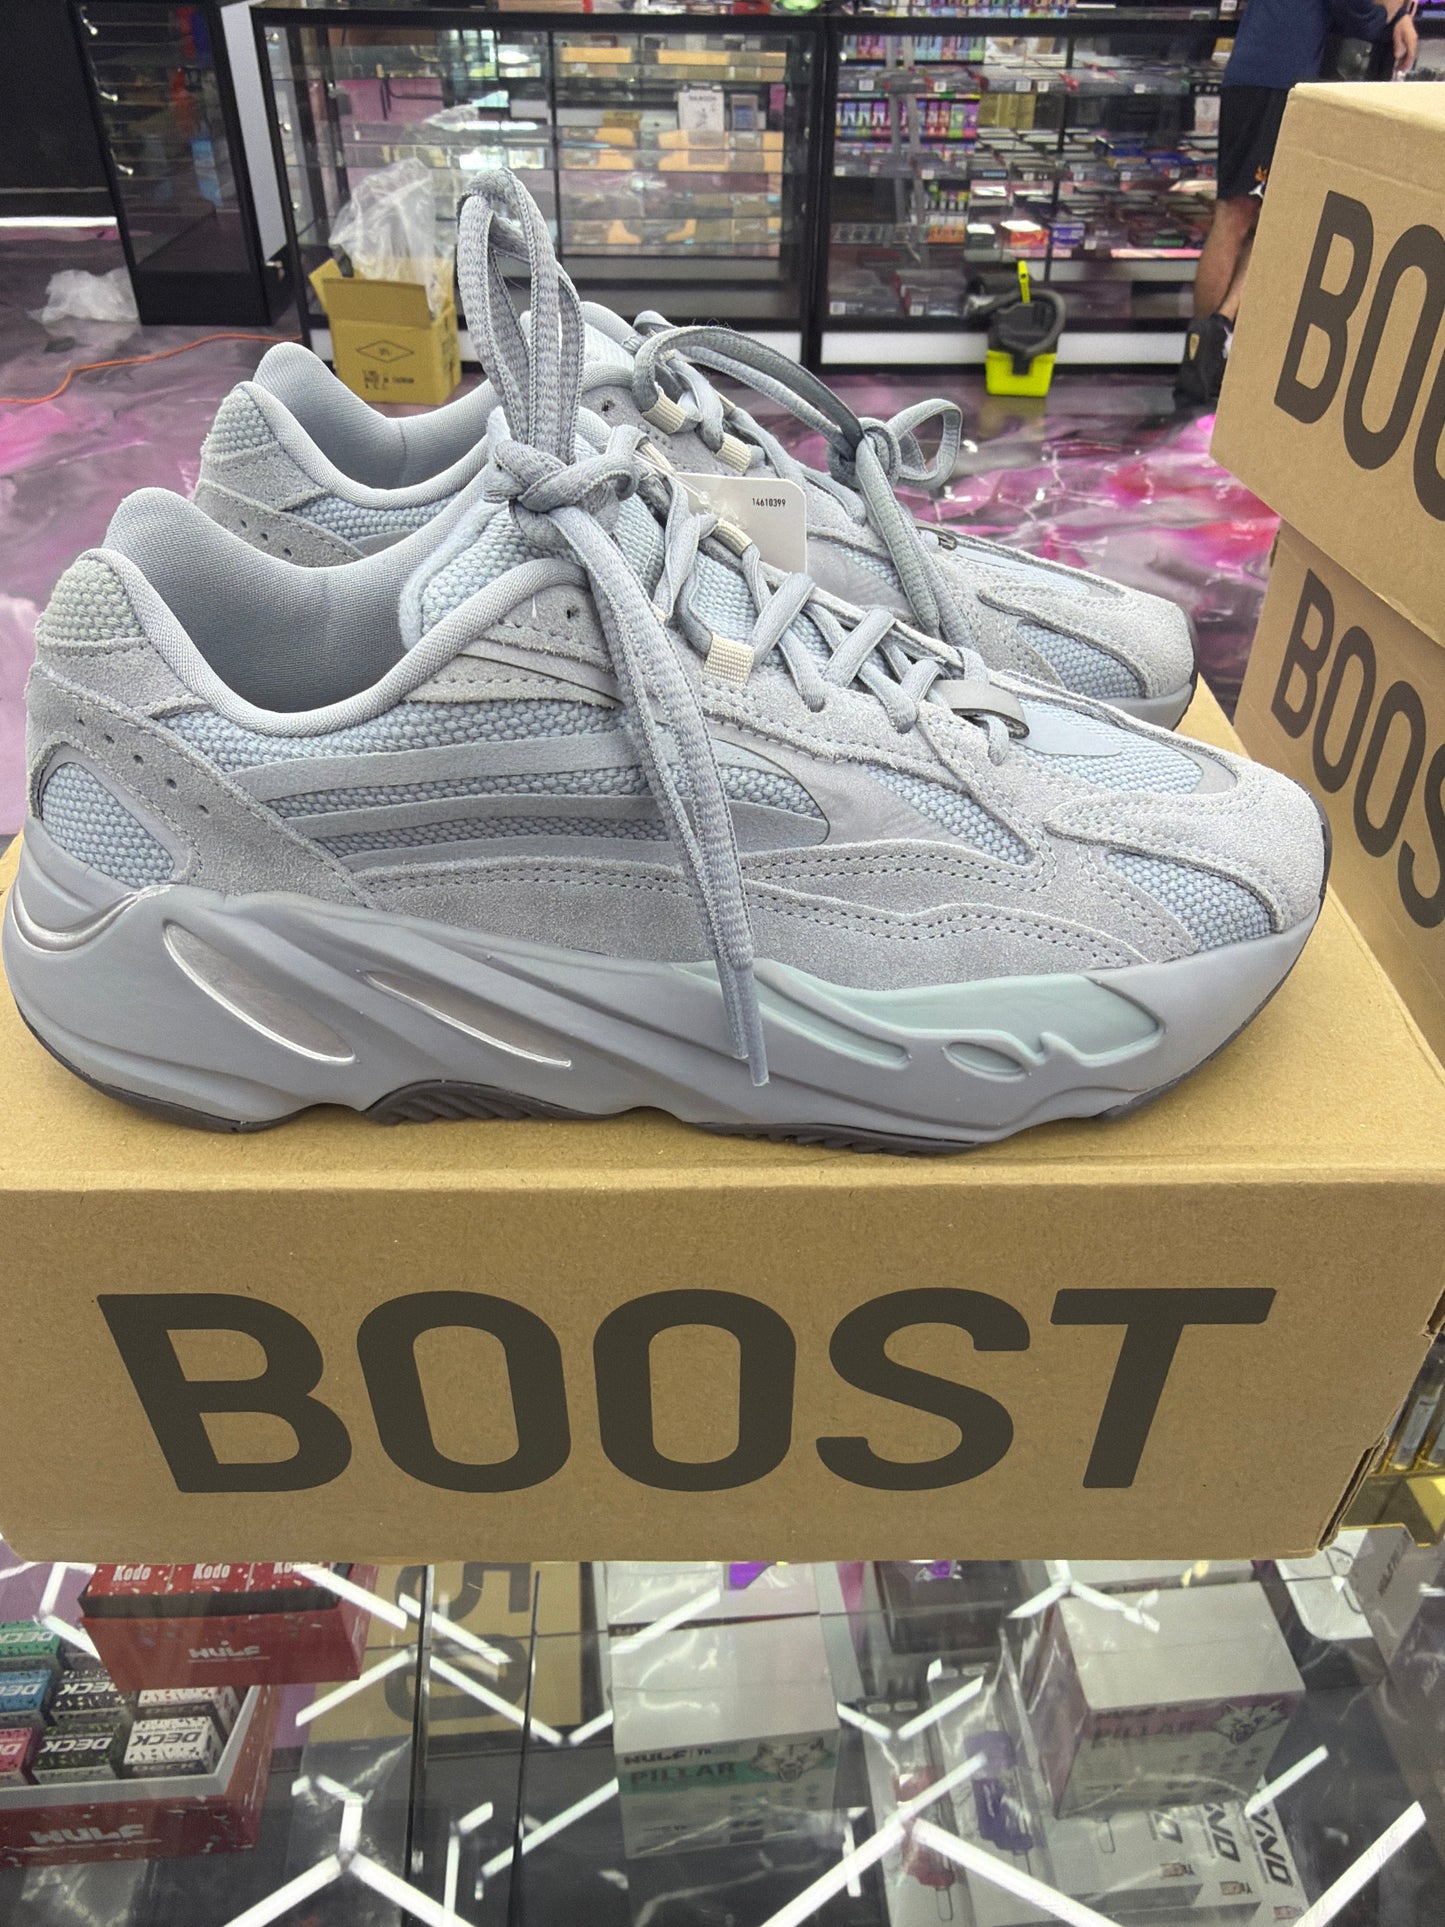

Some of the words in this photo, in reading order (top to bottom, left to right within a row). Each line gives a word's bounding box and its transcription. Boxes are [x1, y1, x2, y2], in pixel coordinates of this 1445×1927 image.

[97, 1288, 1276, 1493] BOOST
[112, 1563, 151, 1581] Kodo
[193, 1563, 230, 1580] Kodo
[39, 1737, 113, 1753] DECK
[131, 1732, 201, 1747] DECK
